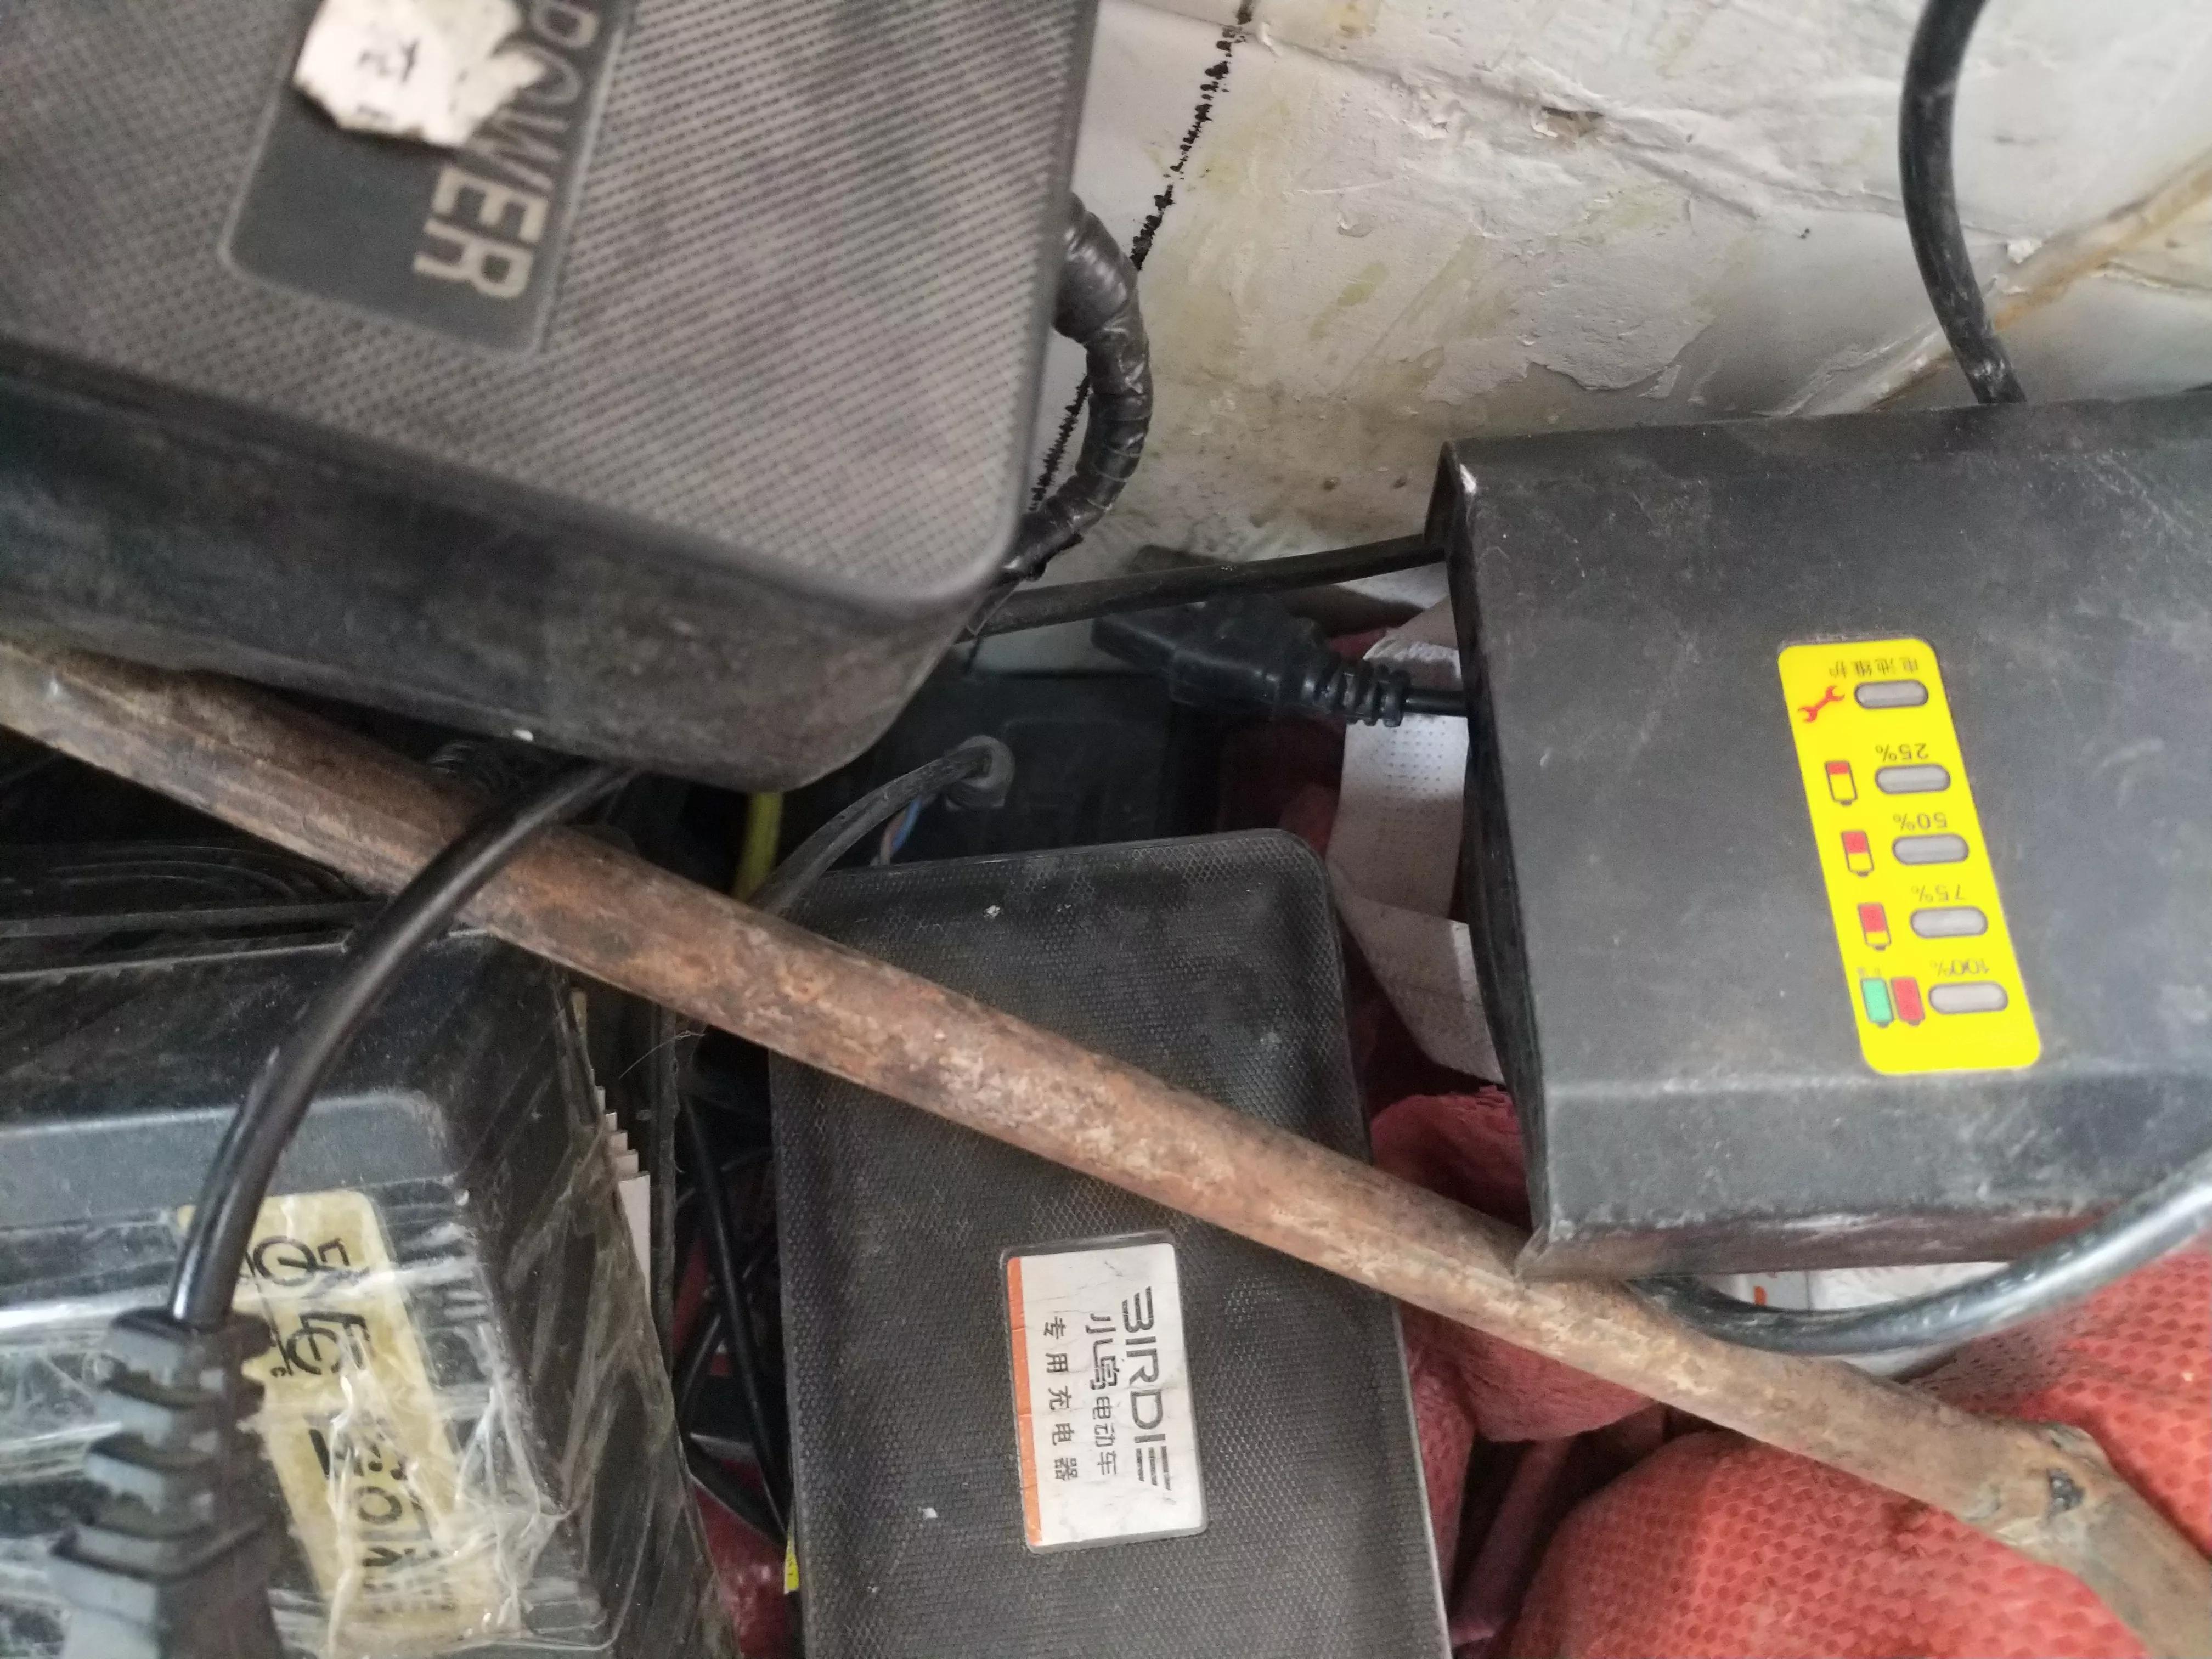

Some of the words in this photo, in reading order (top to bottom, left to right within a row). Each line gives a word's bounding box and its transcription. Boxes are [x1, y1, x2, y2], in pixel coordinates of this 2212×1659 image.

[1828, 657, 1919, 678] 电池维护
[1875, 742, 1929, 762] 25%
[1892, 812, 1948, 831] 50%
[1910, 883, 1966, 902] 75%
[1929, 958, 1990, 977] 100%
[1085, 1313, 1120, 1476] 小鸟电动车
[1121, 1285, 1172, 1492] BIRDIE
[1043, 1316, 1079, 1482] 专用充电器
